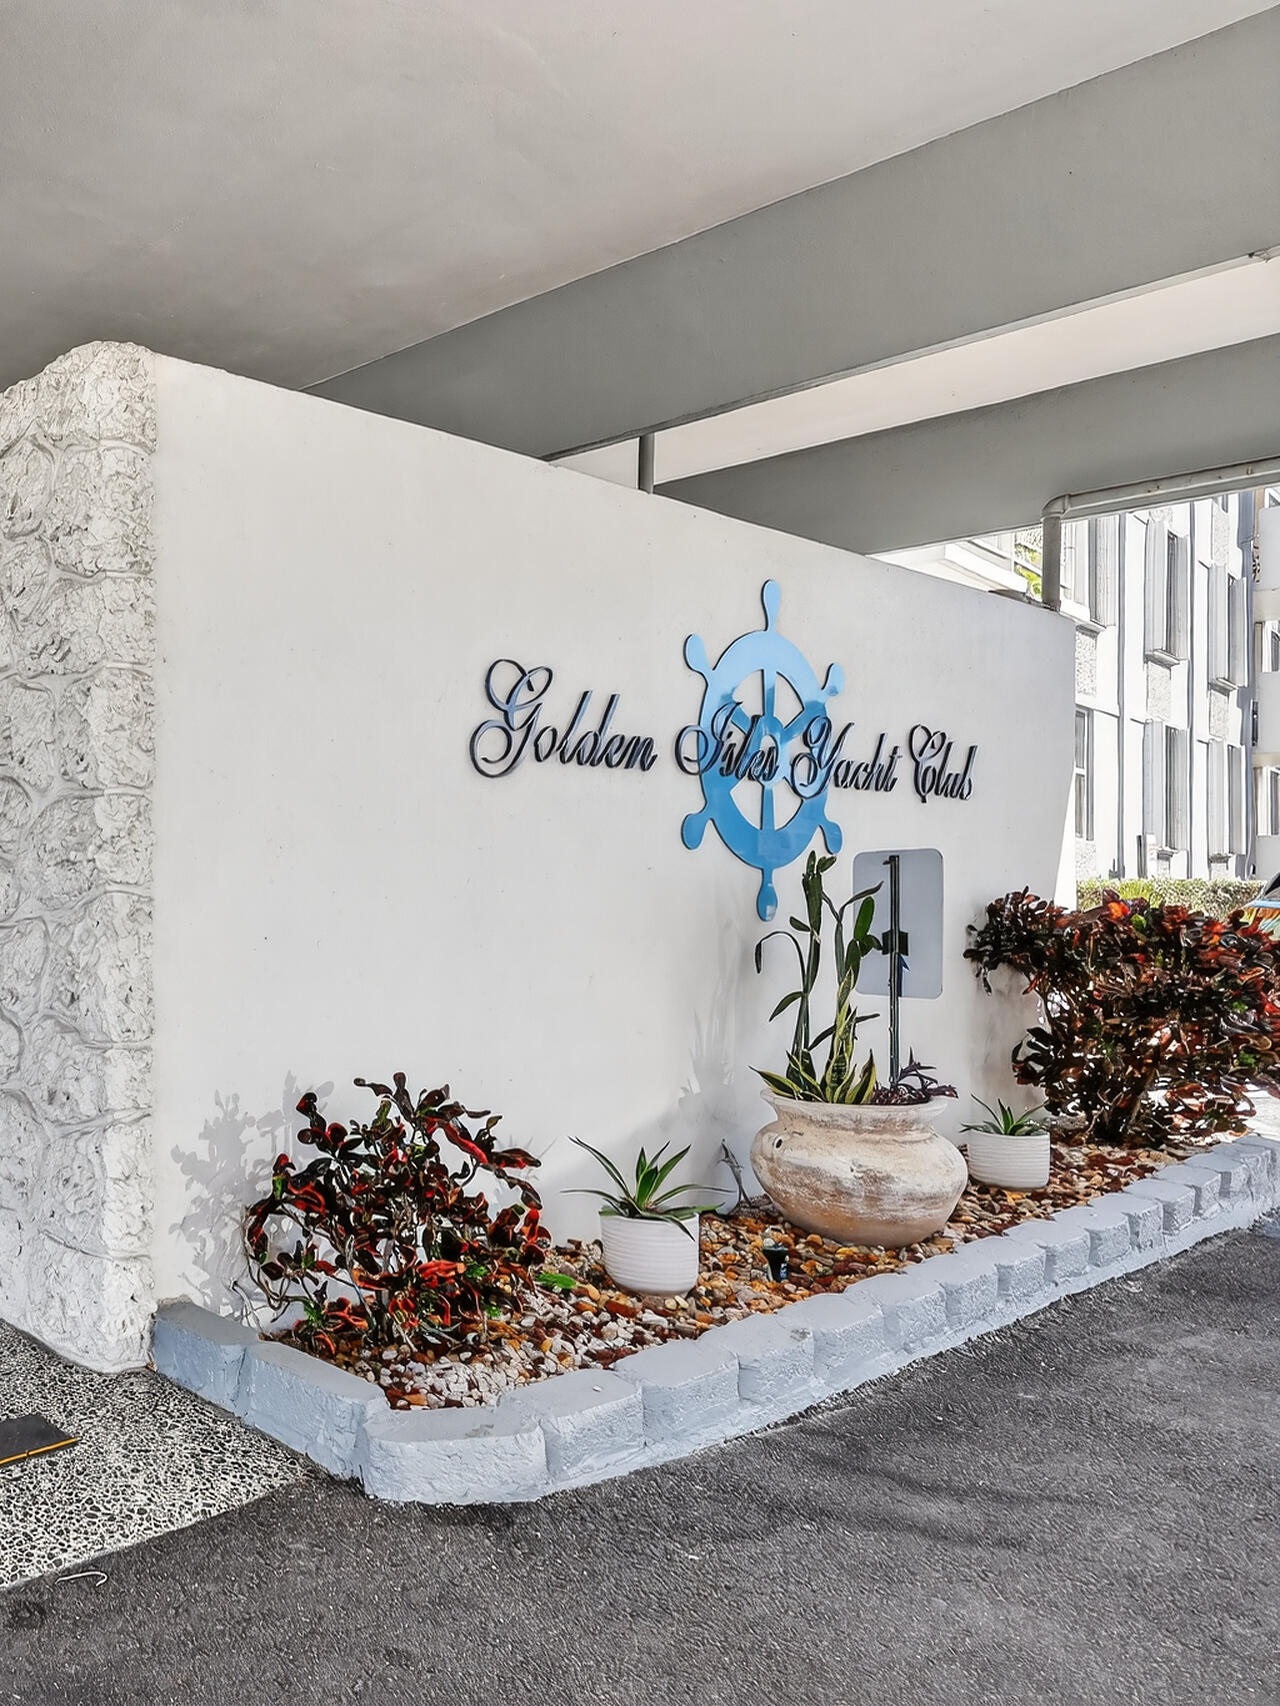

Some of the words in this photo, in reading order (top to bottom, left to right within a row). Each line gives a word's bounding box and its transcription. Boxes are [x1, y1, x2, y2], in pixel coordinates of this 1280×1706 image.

[470, 658, 657, 779] Golden
[674, 701, 780, 782] Isles
[789, 716, 904, 800] Yacht
[908, 724, 979, 804] Club
